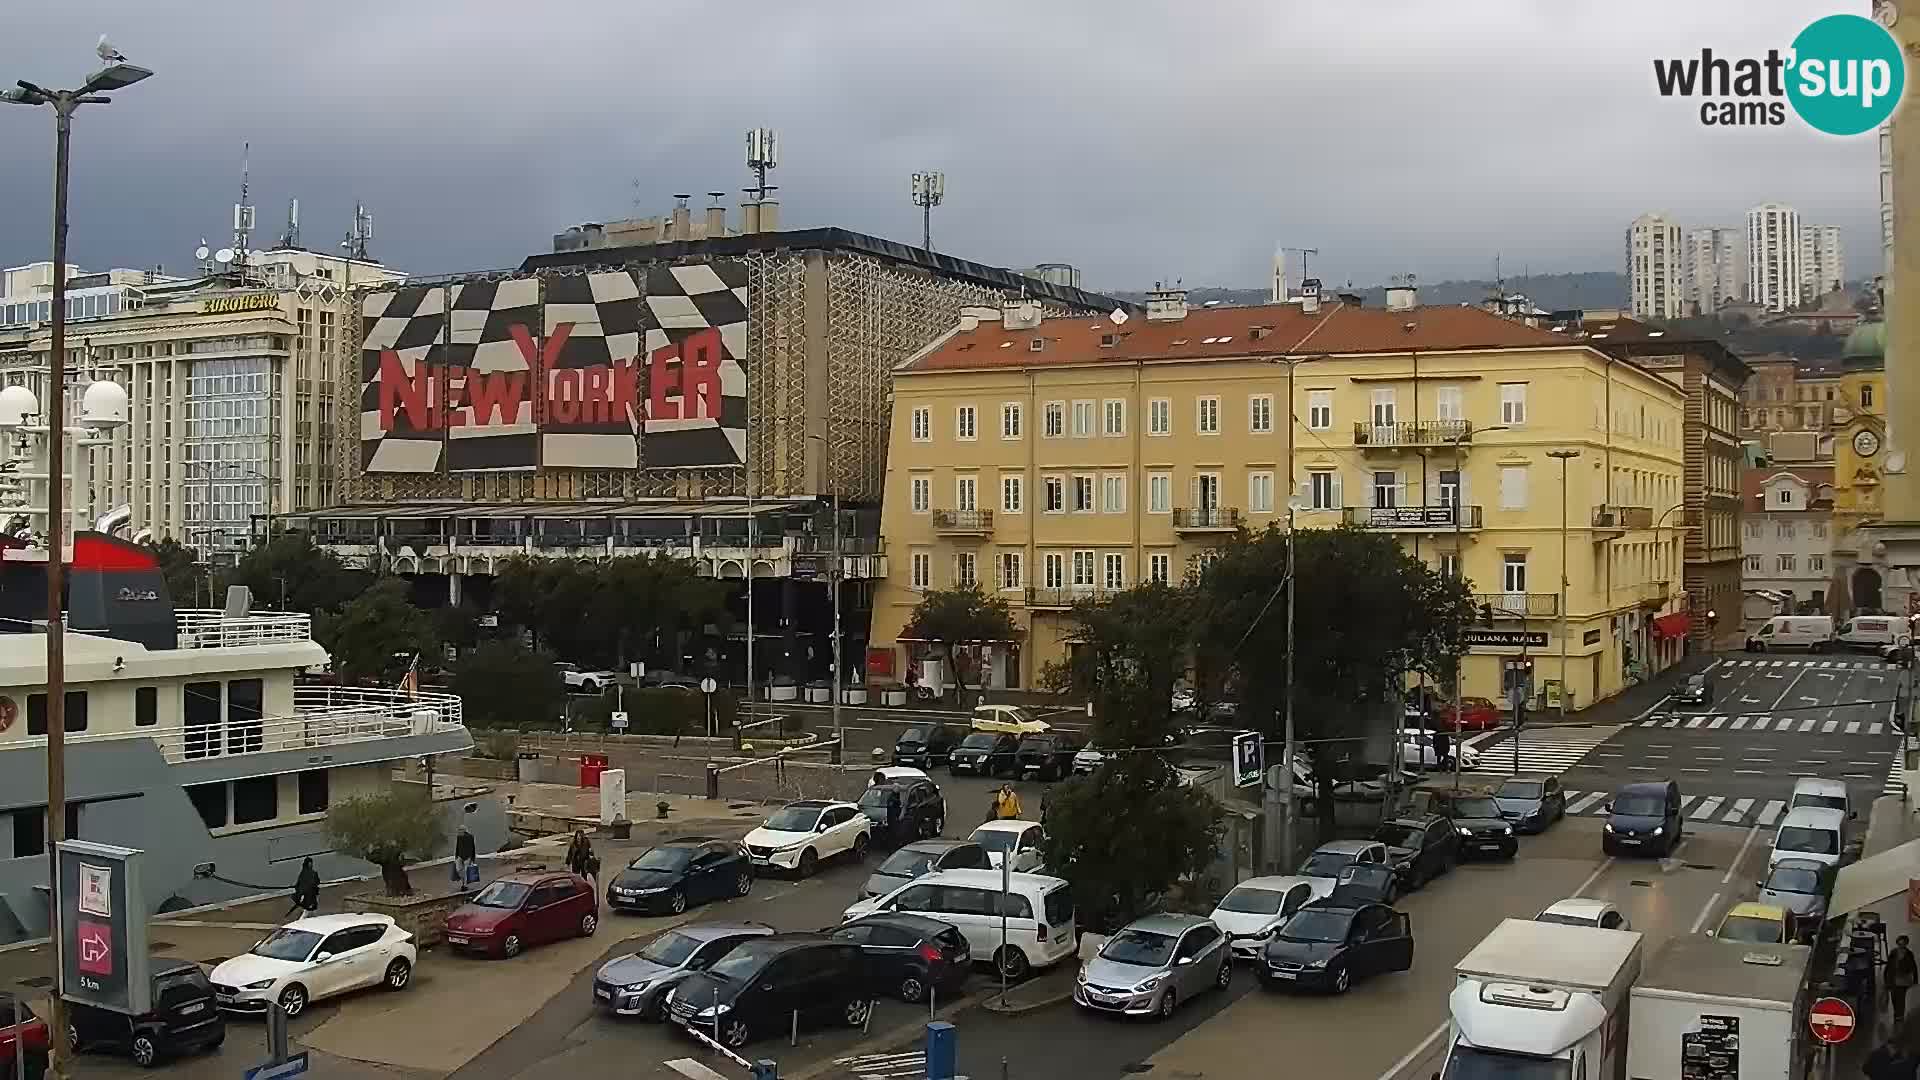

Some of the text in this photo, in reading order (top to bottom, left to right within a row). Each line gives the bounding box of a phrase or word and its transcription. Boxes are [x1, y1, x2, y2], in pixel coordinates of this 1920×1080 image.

[378, 321, 723, 432] NEW YORKER
[1464, 634, 1543, 643] JULIANA NAILS
[80, 976, 100, 991] 5 km
